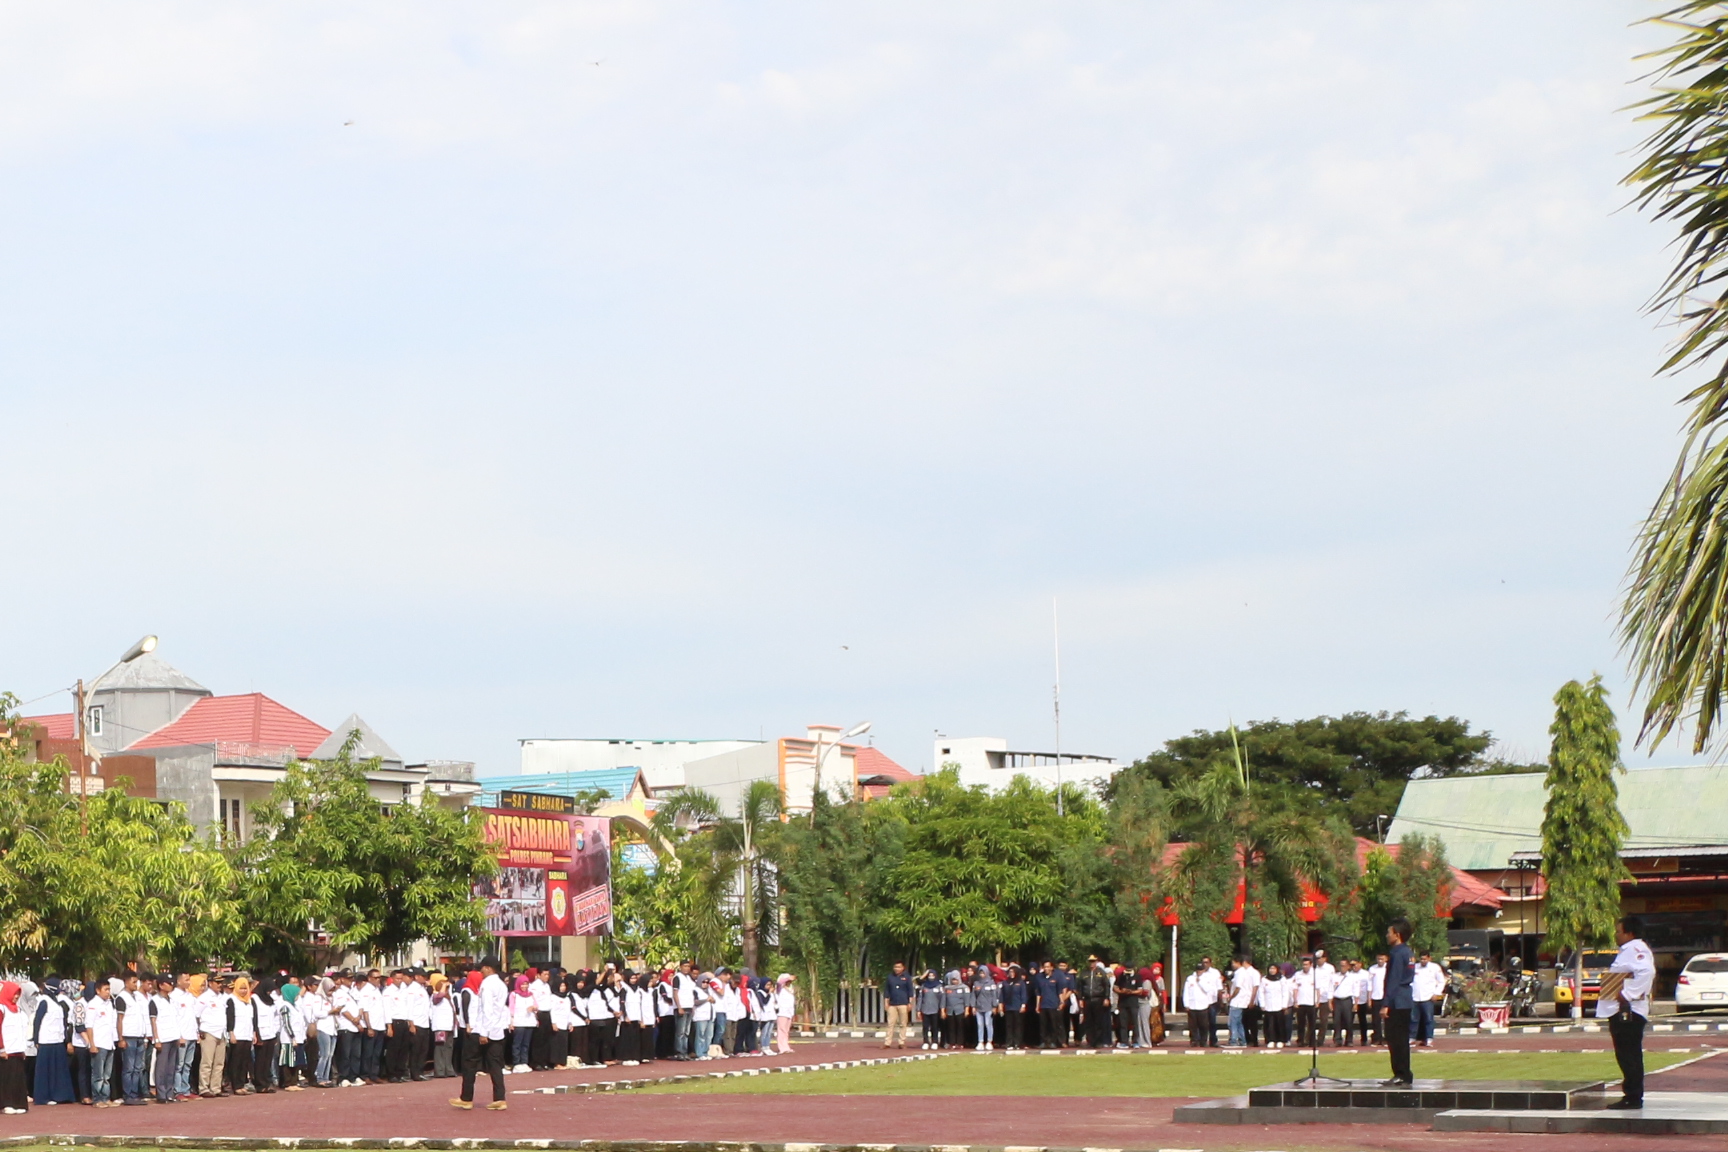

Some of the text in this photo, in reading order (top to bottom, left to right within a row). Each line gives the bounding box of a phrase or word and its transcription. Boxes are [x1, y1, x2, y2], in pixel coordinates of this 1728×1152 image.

[512, 794, 565, 811] SAT SABHARA
[510, 849, 530, 864] POLRES
